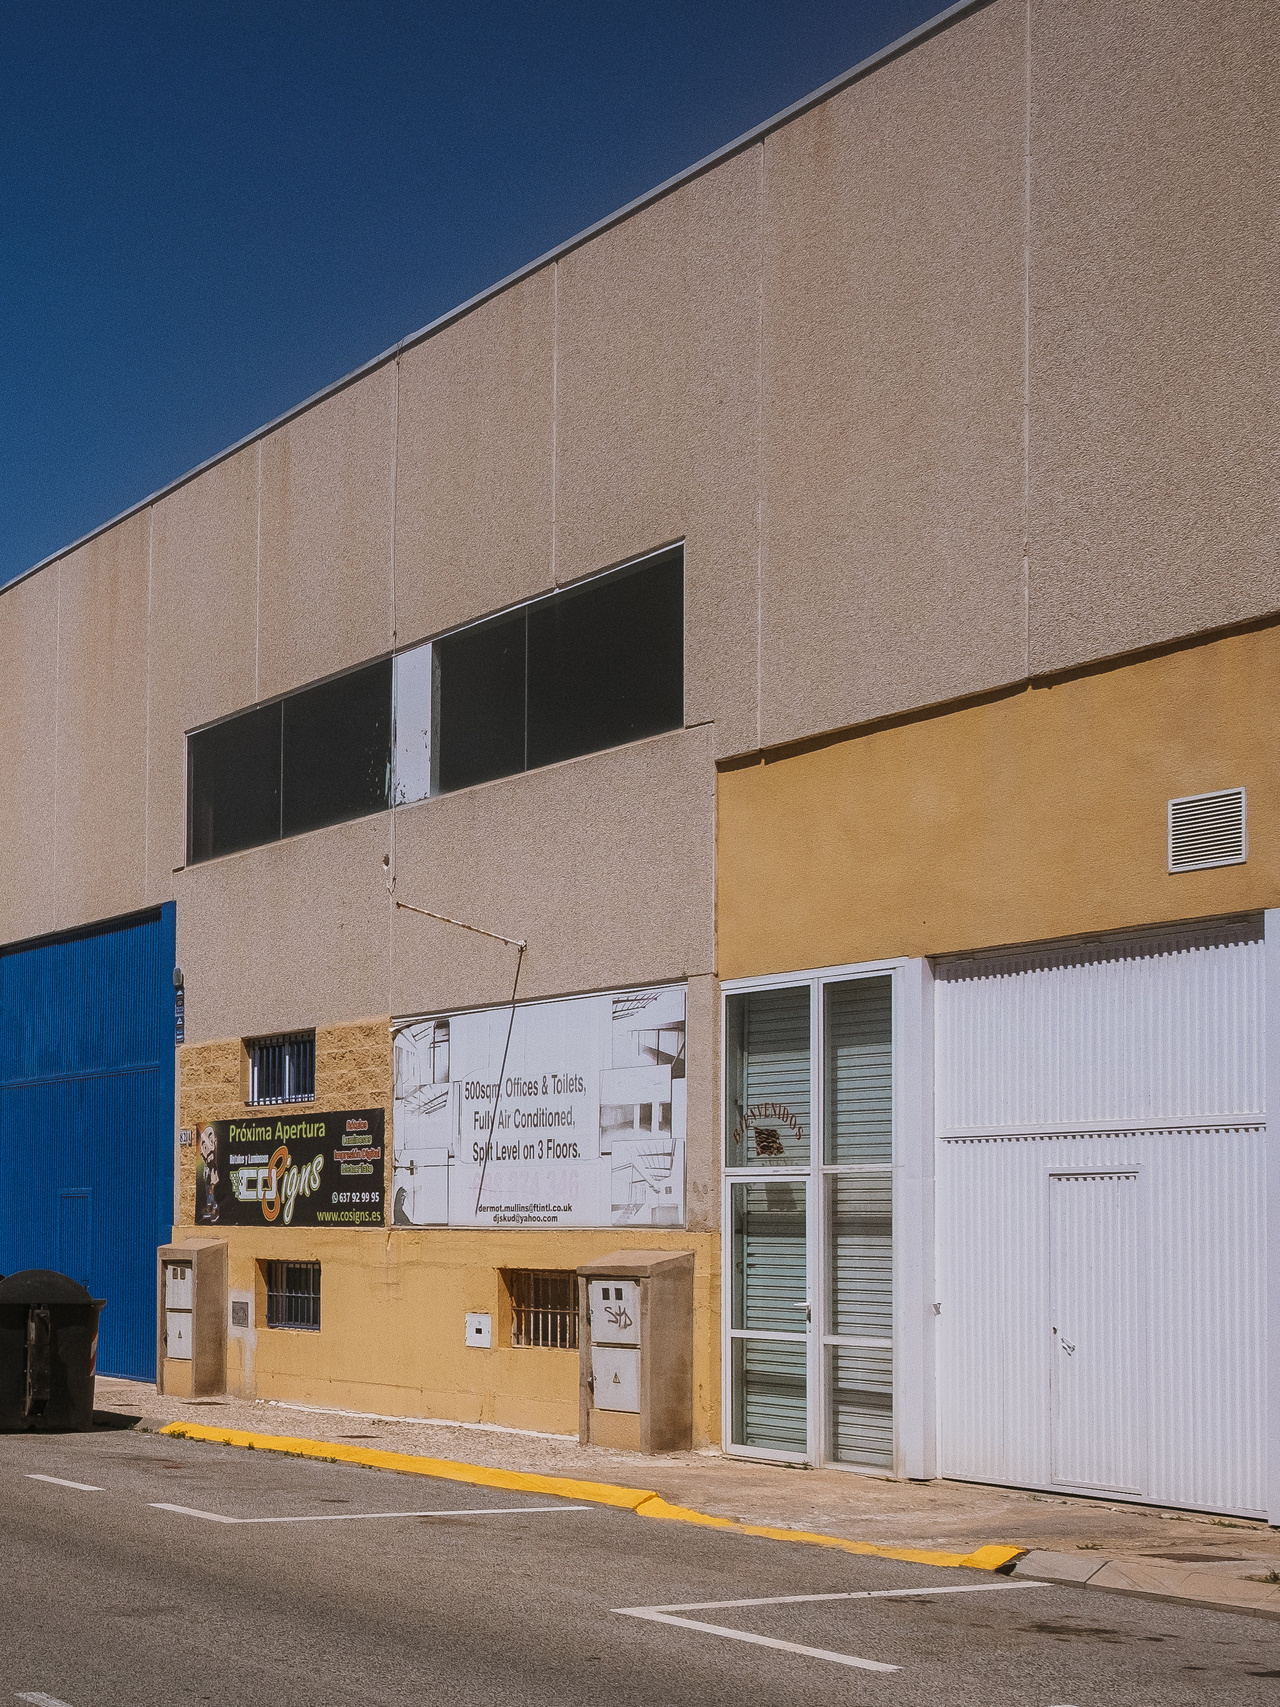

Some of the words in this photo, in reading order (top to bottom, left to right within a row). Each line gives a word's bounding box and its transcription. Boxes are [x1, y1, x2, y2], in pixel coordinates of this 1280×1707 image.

[505, 1077, 539, 1098] Offices
[541, 1075, 548, 1095] &
[551, 1073, 587, 1096] Toilets,
[497, 1109, 512, 1130] Air
[513, 1105, 576, 1130] Conditioned,
[733, 1103, 803, 1144] BIENVENIDOS
[229, 1122, 272, 1143] Próxima
[274, 1120, 326, 1144] Apertura
[495, 1140, 521, 1161] Level
[523, 1143, 535, 1160] on
[537, 1140, 544, 1160] 3
[546, 1138, 581, 1159] Floors.
[339, 1192, 351, 1203] 637
[351, 1192, 361, 1203] 92
[361, 1192, 370, 1203] 99
[370, 1192, 380, 1203] 95
[316, 1208, 381, 1225] www.cosigns.es
